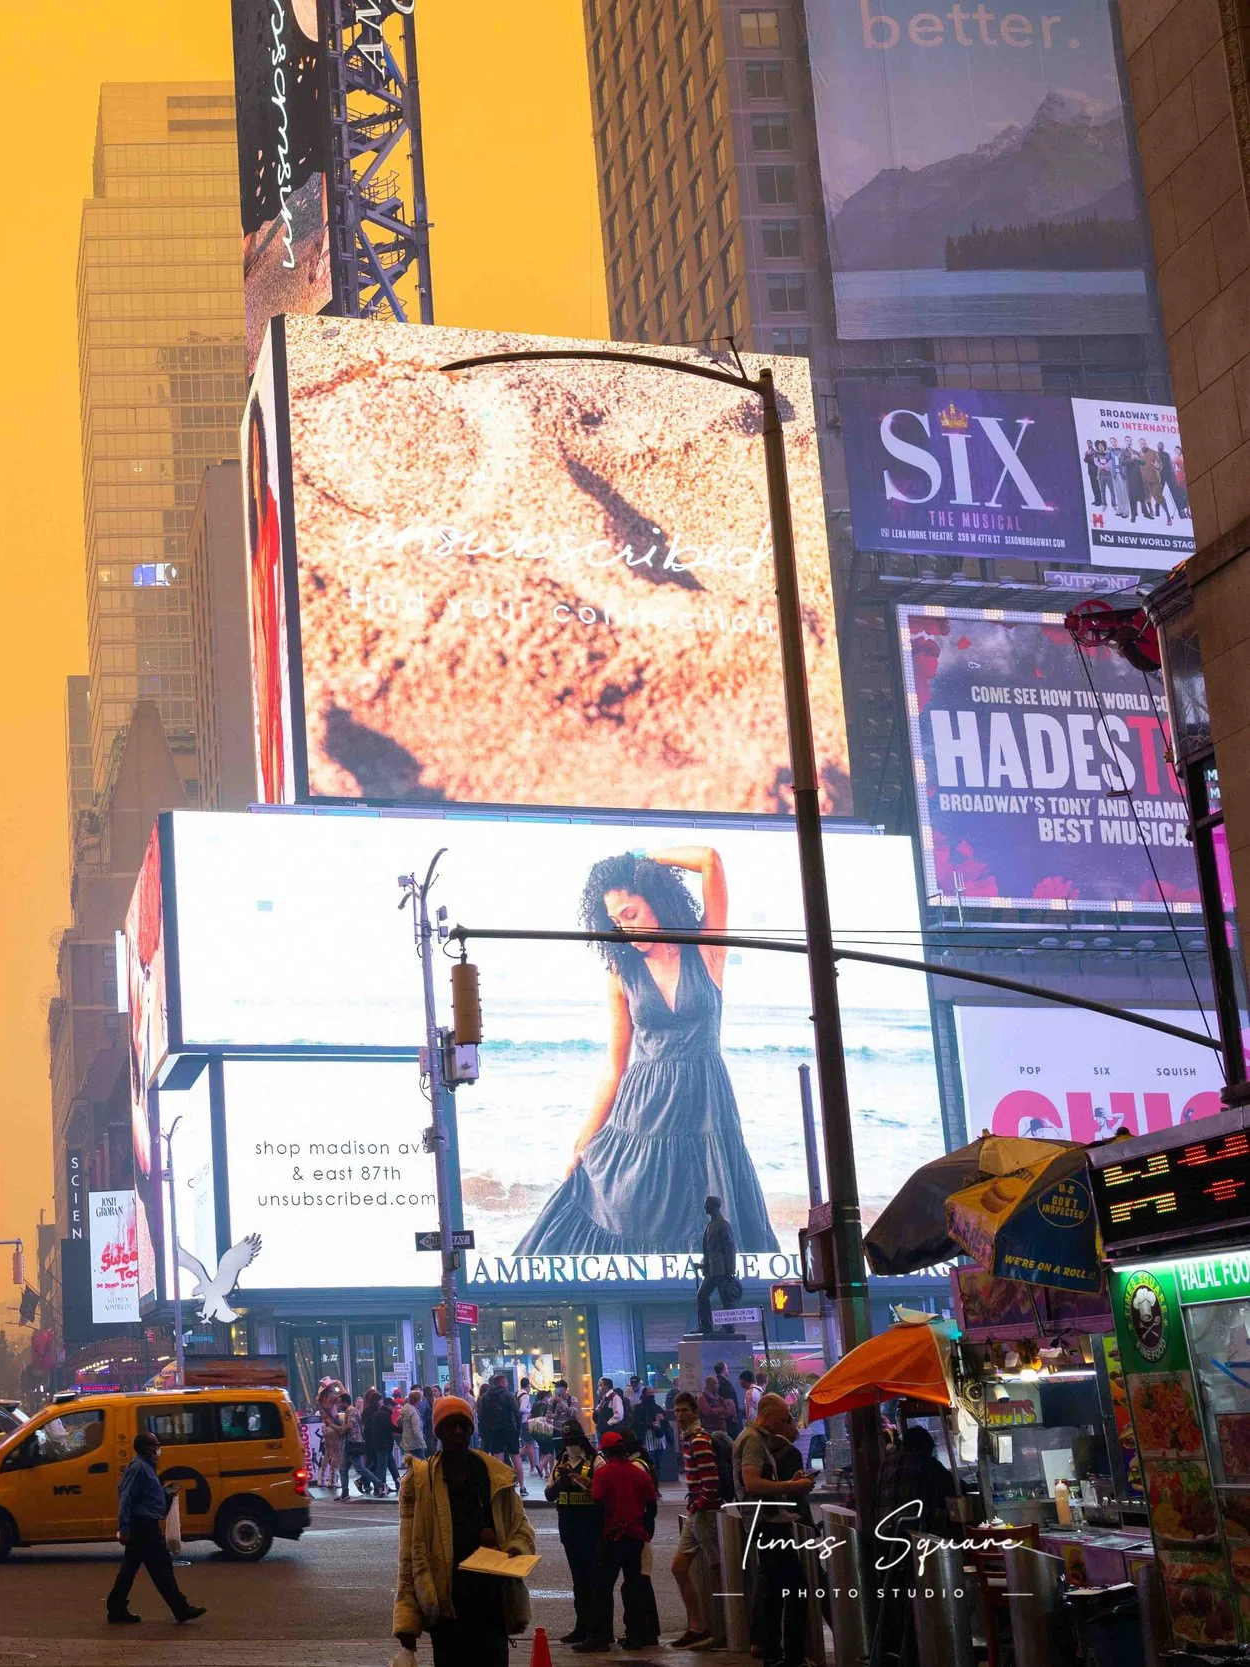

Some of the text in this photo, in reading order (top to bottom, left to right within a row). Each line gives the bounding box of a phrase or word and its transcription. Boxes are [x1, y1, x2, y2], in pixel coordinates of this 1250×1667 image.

[862, 0, 1081, 49] better.
[270, 0, 296, 269] unsubsc
[1100, 408, 1178, 423] BROADWAY'S FUN
[1100, 420, 1179, 433] AND INTERNATIO
[880, 408, 1054, 512] SIX
[929, 510, 1023, 531] THE MUSICAL
[892, 530, 907, 539] LENA
[908, 531, 927, 540] HORNE
[929, 531, 954, 541] THEATRE
[970, 534, 976, 542] W
[993, 535, 1000, 544] ST
[1117, 535, 1138, 545] NEW
[1138, 536, 1171, 547] WORLD
[1172, 540, 1196, 549] STAG
[1054, 573, 1129, 593] OUTFRONT
[446, 595, 533, 622] your
[552, 600, 775, 634] connection
[971, 686, 1169, 712] COME SEE HOW THE WORLD CO
[939, 793, 1189, 820] BROADWAY'S TONY AND GRAMM
[1037, 817, 1094, 844] BEST
[1019, 1066, 1041, 1075] POP
[1093, 1067, 1111, 1076] SIX
[1156, 1067, 1197, 1076] SQUISH
[255, 1140, 422, 1158] shop madison av
[292, 1165, 401, 1181] & east 87th
[71, 1156, 83, 1240] SCIEN
[101, 1197, 117, 1207] JOSH
[257, 1191, 436, 1207] unsubscribed.com
[95, 1205, 124, 1218] GROBAN
[1042, 1203, 1084, 1220] INSPECTED
[473, 1255, 650, 1284] AMERICAN
[661, 1253, 761, 1281] EAE
[1004, 1254, 1035, 1269] WE'RE
[1037, 1261, 1052, 1272] ON
[1053, 1264, 1061, 1274] A
[1063, 1266, 1086, 1279] ROLL
[1179, 1257, 1250, 1291] HALAL FOO
[987, 1398, 1037, 1425] NUTS
[300, 1424, 313, 1481] CHICAGO
[53, 1485, 82, 1495] NYC
